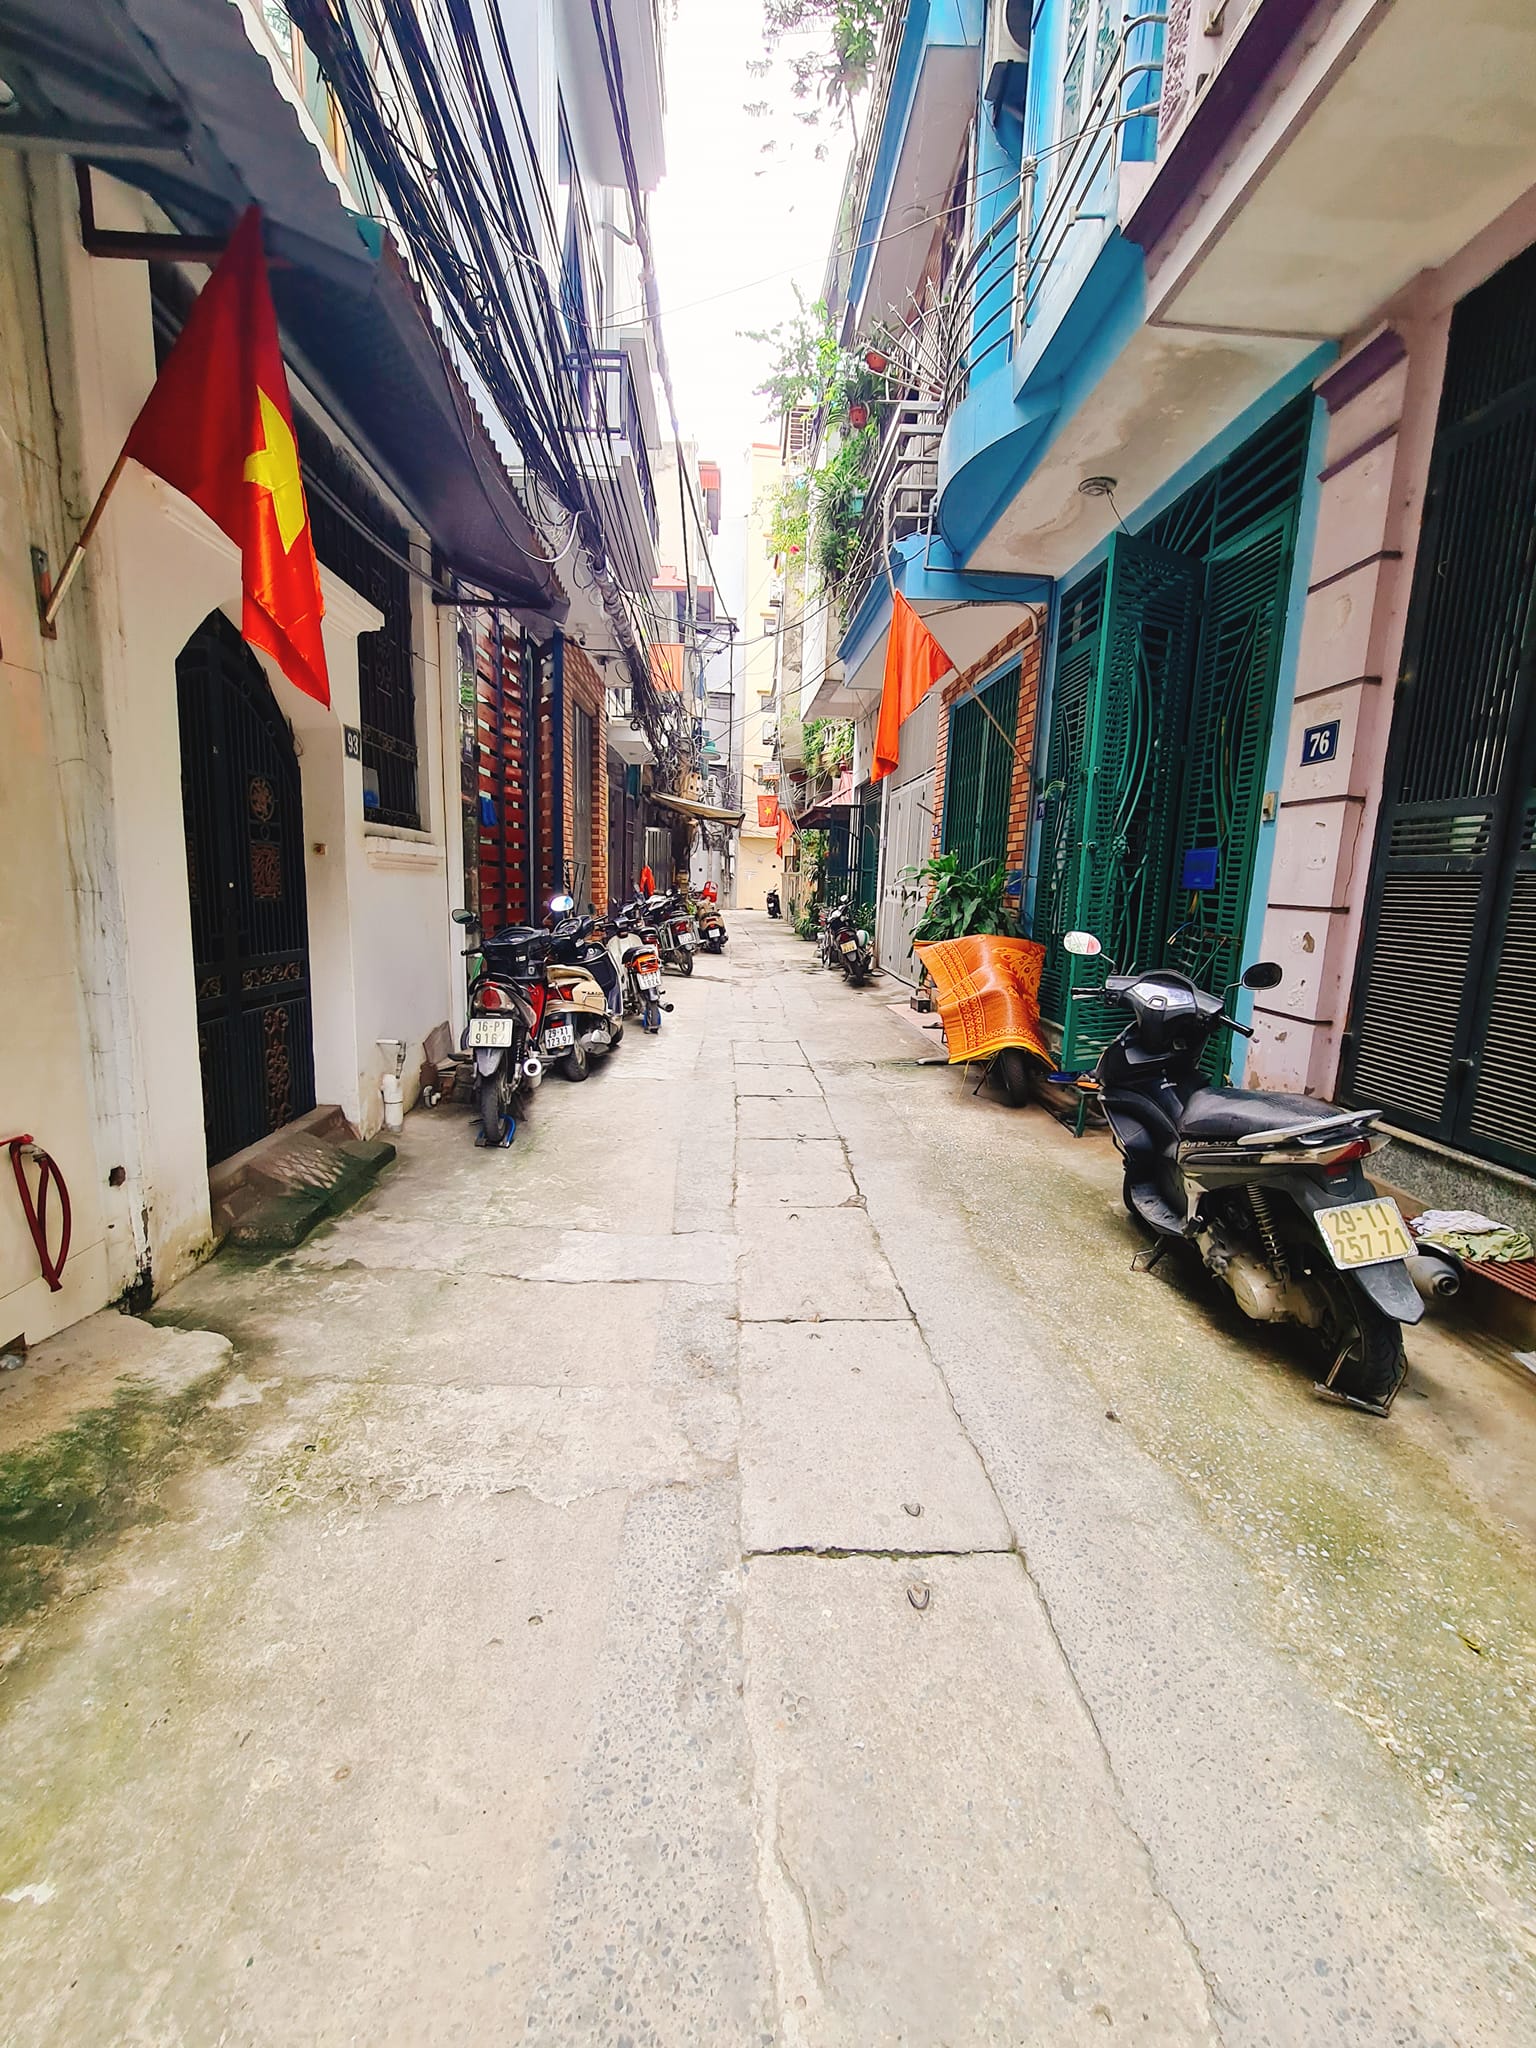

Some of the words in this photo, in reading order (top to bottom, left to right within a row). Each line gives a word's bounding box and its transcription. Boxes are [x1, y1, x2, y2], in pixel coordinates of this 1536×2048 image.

[347, 732, 358, 754] 93
[1310, 730, 1330, 758] 76
[477, 1021, 506, 1032] 16-P1
[1328, 1203, 1390, 1235] 29-T1
[1334, 1227, 1408, 1261] 257.71
